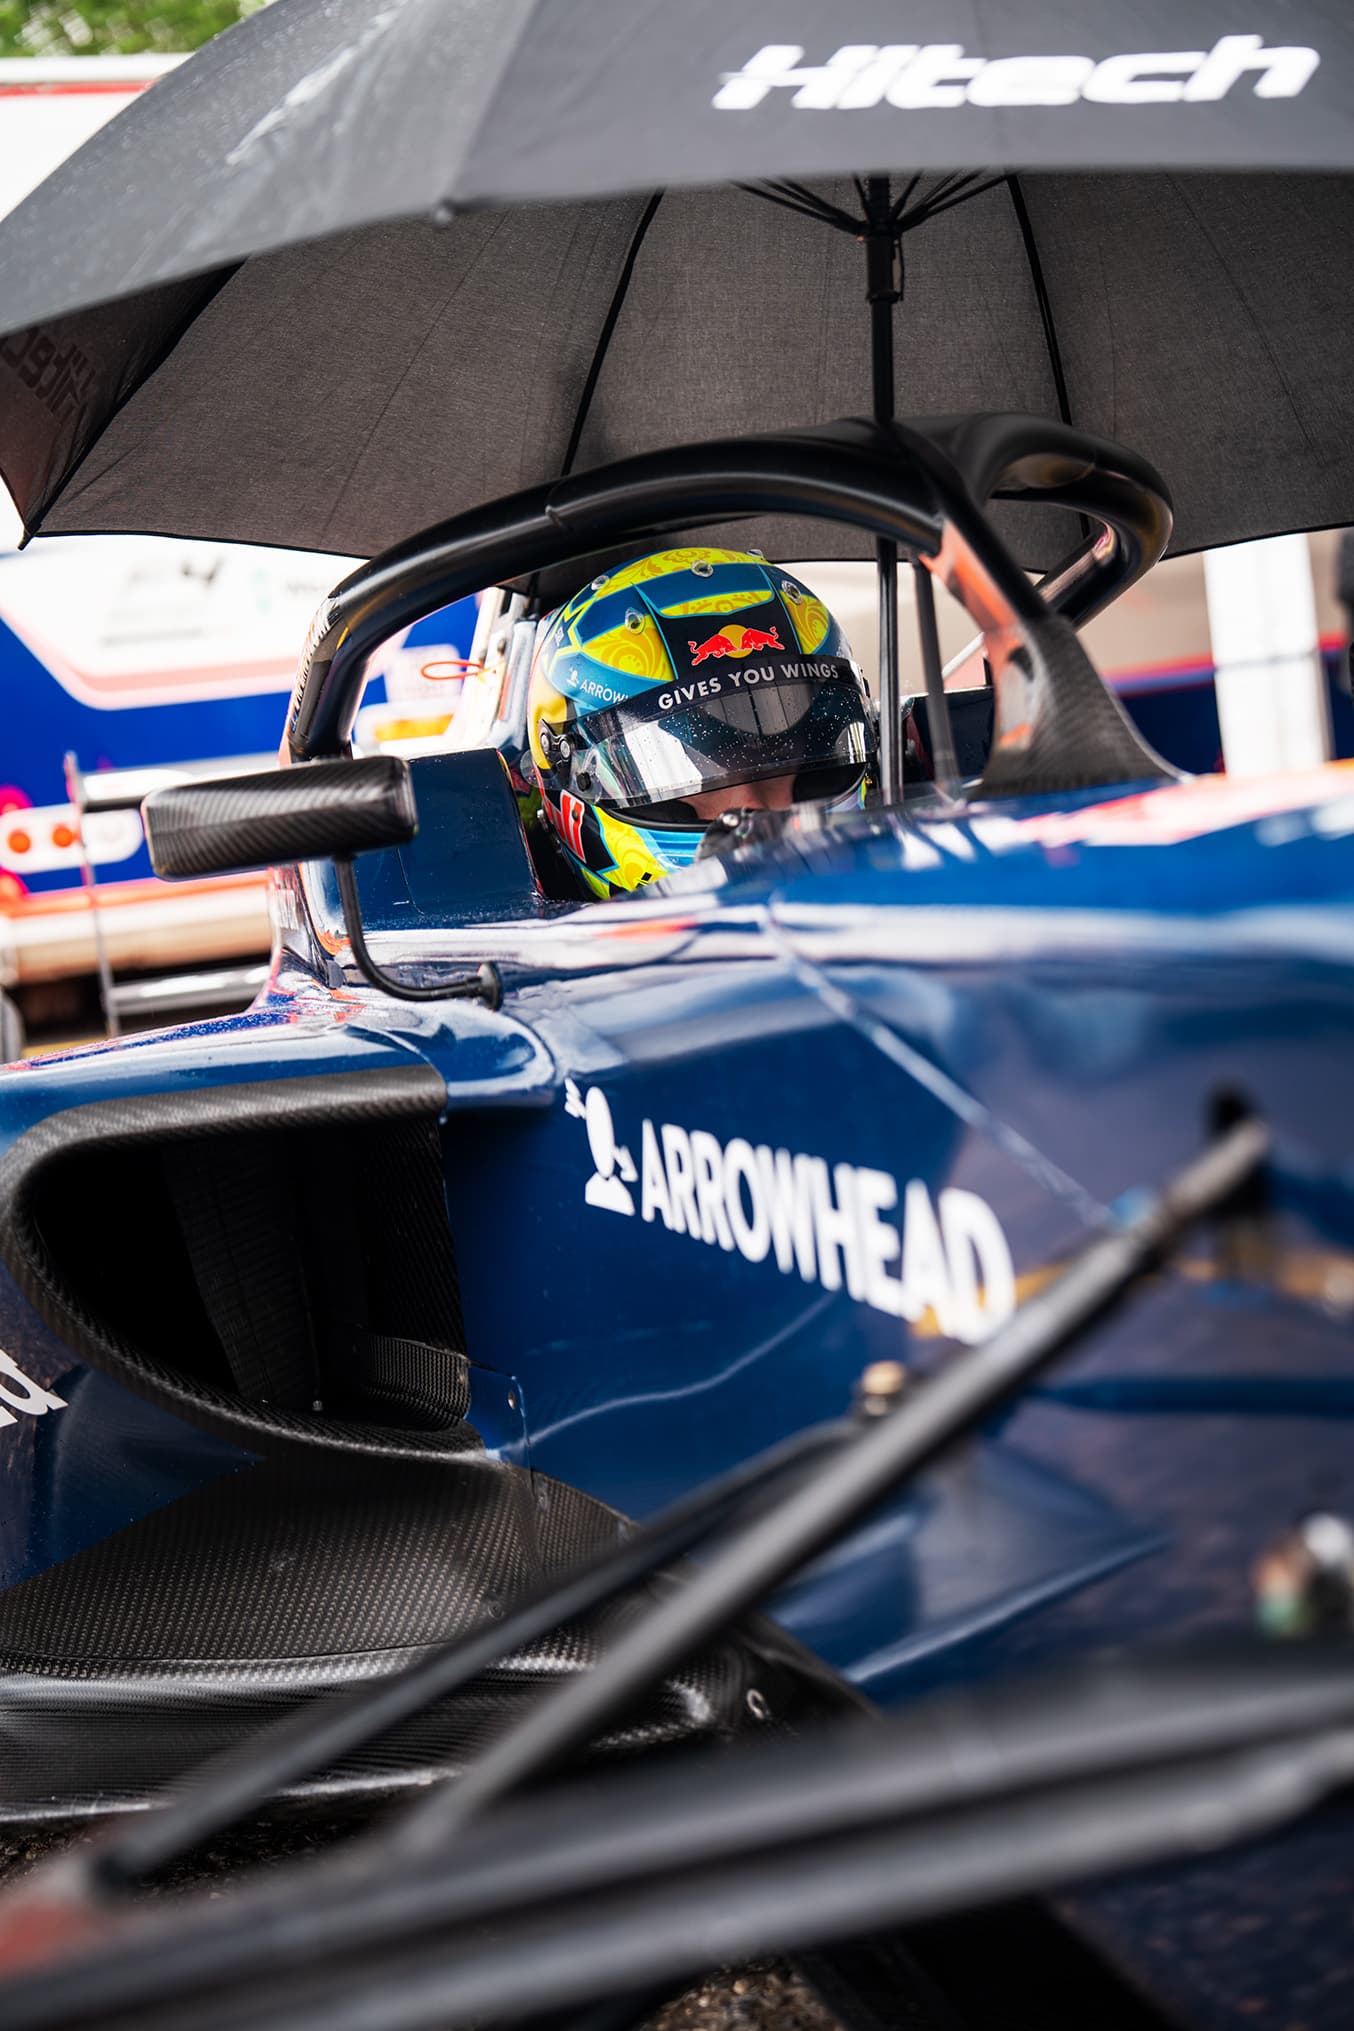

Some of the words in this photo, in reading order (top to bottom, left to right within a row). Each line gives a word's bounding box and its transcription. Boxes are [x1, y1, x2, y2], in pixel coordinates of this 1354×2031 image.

[712, 34, 1320, 109] Hitech
[579, 679, 629, 704] ARROW
[658, 677, 722, 710] GIVES
[728, 666, 775, 688] YOU
[780, 663, 839, 679] WINGS
[641, 1117, 1016, 1345] ARROWHEAD
